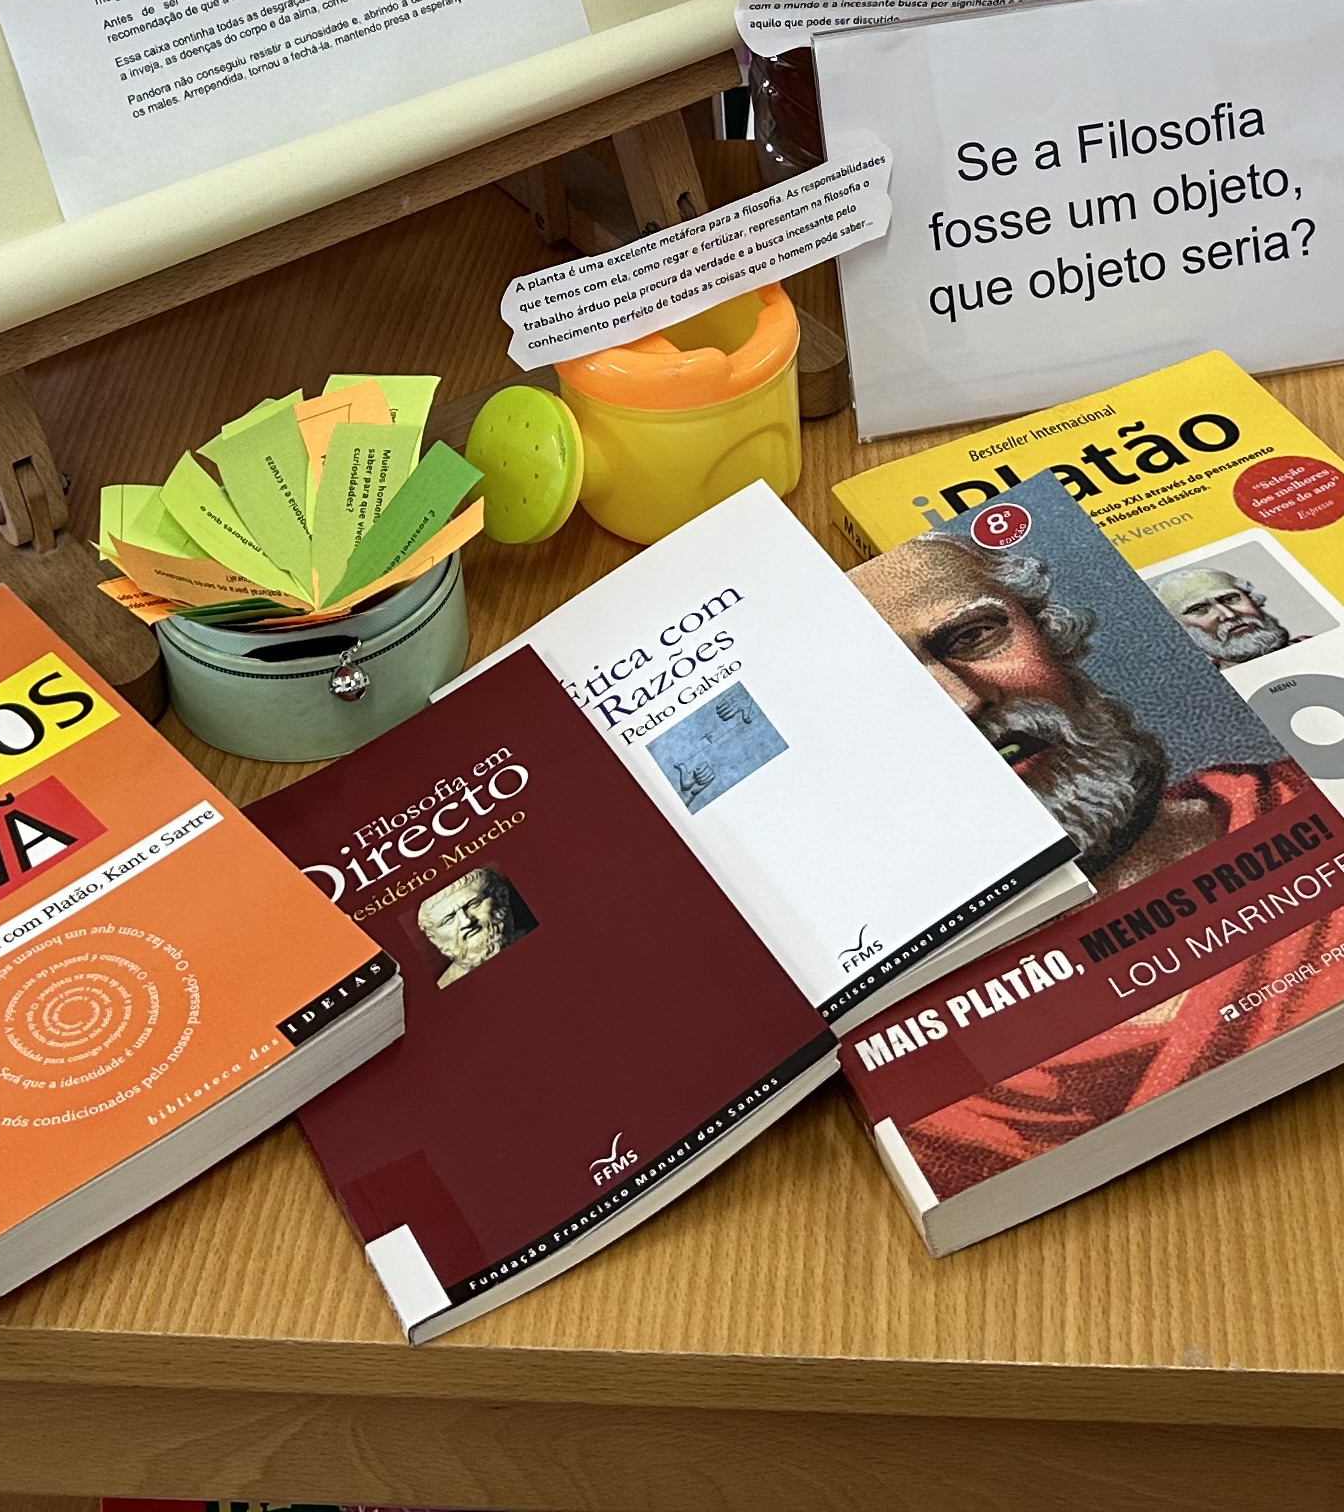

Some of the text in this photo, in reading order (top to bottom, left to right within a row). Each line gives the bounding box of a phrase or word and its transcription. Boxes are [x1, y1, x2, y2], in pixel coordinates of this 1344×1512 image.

[107, 11, 183, 43] recomendação
[185, 6, 199, 17] de
[200, 0, 220, 12] que
[958, 102, 1265, 181] Se a Filosofia
[516, 282, 525, 293] A
[528, 272, 566, 291] planta
[568, 266, 576, 277] é
[578, 261, 604, 274] uma
[607, 242, 657, 266] excelente
[659, 225, 706, 247] metáfora
[708, 215, 731, 231] para
[786, 189, 799, 200] As
[801, 156, 885, 194] responsabilidades
[928, 164, 1301, 251] fosse um objeto,
[930, 218, 1315, 323] que objeto seria?
[365, 448, 376, 474] saber
[969, 404, 1116, 462] Bestseller Internacional
[345, 447, 361, 513] curiosidades?
[361, 477, 372, 500] para
[377, 449, 390, 483] Muitos
[1088, 446, 1275, 518] éculo XXI através do pensamento
[1252, 468, 1330, 508] dos melhores
[358, 501, 369, 521] que
[1107, 503, 1157, 525] filósofos
[1129, 510, 1193, 538] Vernon
[1258, 499, 1295, 519] livros
[1297, 489, 1312, 502] do
[660, 588, 745, 646] com
[593, 630, 734, 731] Razões
[619, 660, 742, 746] Pedro Galvão
[1269, 679, 1297, 695] MENU
[353, 747, 513, 850] Filosofia em
[3, 918, 43, 943] com
[41, 884, 103, 920] Platão,
[102, 853, 148, 882] Kant
[149, 845, 160, 854] e
[160, 811, 214, 846] Sartre
[347, 810, 526, 922] esidério Murcho
[821, 877, 1018, 1018] ancisco Manuel dos Santos
[841, 939, 884, 975] FFMS
[855, 814, 1335, 1072] MAIS PLATÃO, MENOS PROZAC!
[1107, 946, 1181, 999] LOU
[1238, 961, 1319, 1013] EDITORIAL
[147, 962, 382, 1125] biblioteca das IDEIAS
[2, 1115, 29, 1127] nós
[33, 1084, 141, 1127] condicionados
[141, 1062, 169, 1088] pelo
[168, 1027, 193, 1062] nosso
[469, 1074, 779, 1290] Fundação Francisco Manuel dos Santos
[592, 1149, 639, 1187] FFMS
